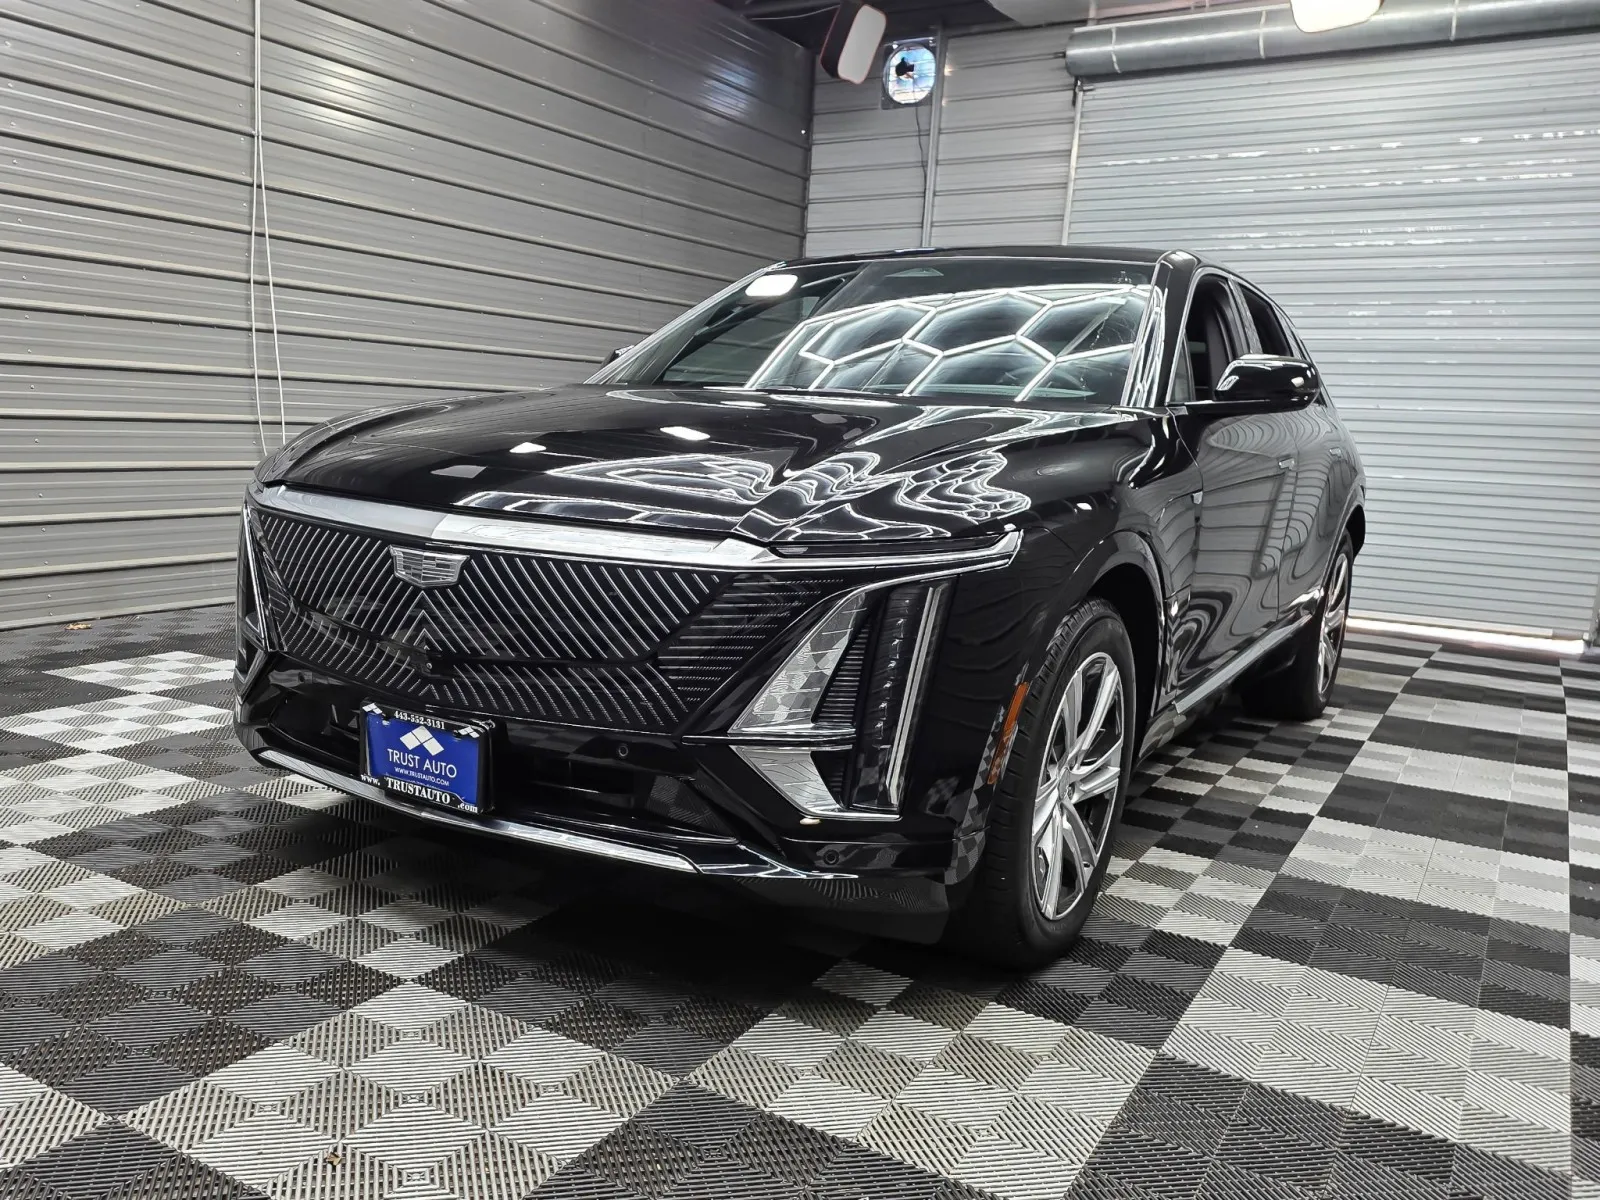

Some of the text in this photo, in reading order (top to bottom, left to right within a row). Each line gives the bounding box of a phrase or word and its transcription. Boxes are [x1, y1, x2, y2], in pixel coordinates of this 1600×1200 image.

[387, 748, 457, 778] TRUST AUTO
[394, 766, 450, 787] WWW.TRUSTAUTO.COM
[361, 774, 381, 786] www.
[386, 777, 450, 804] TRUSTAUTO
